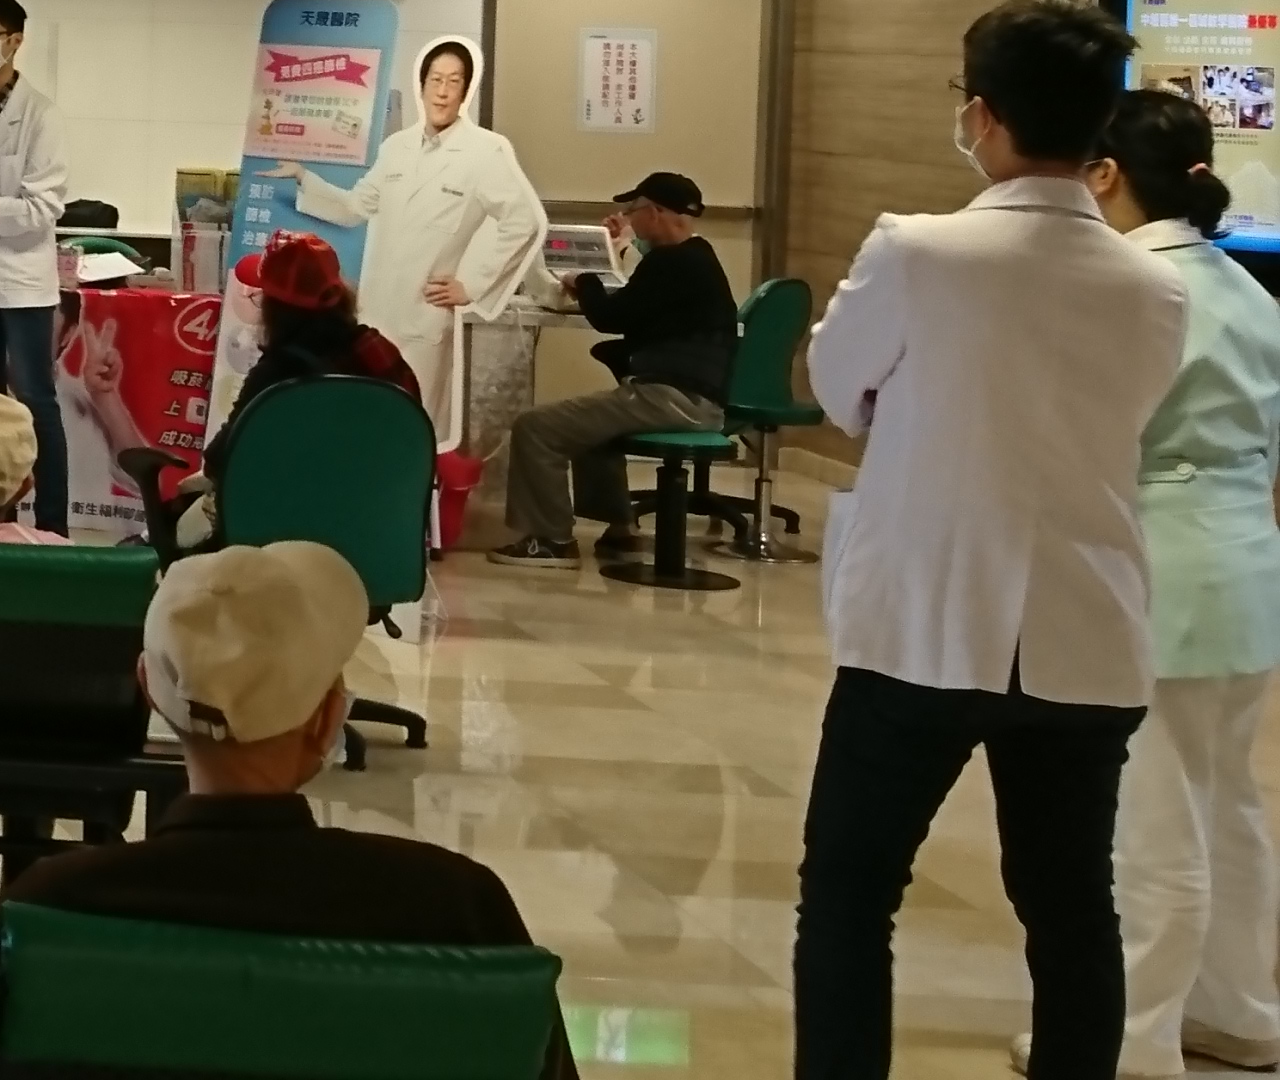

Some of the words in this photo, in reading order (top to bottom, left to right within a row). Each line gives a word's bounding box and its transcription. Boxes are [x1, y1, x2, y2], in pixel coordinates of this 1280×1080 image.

[300, 11, 360, 27] 天晟醫院
[170, 370, 213, 392] 吸菸
[163, 400, 181, 416] 上
